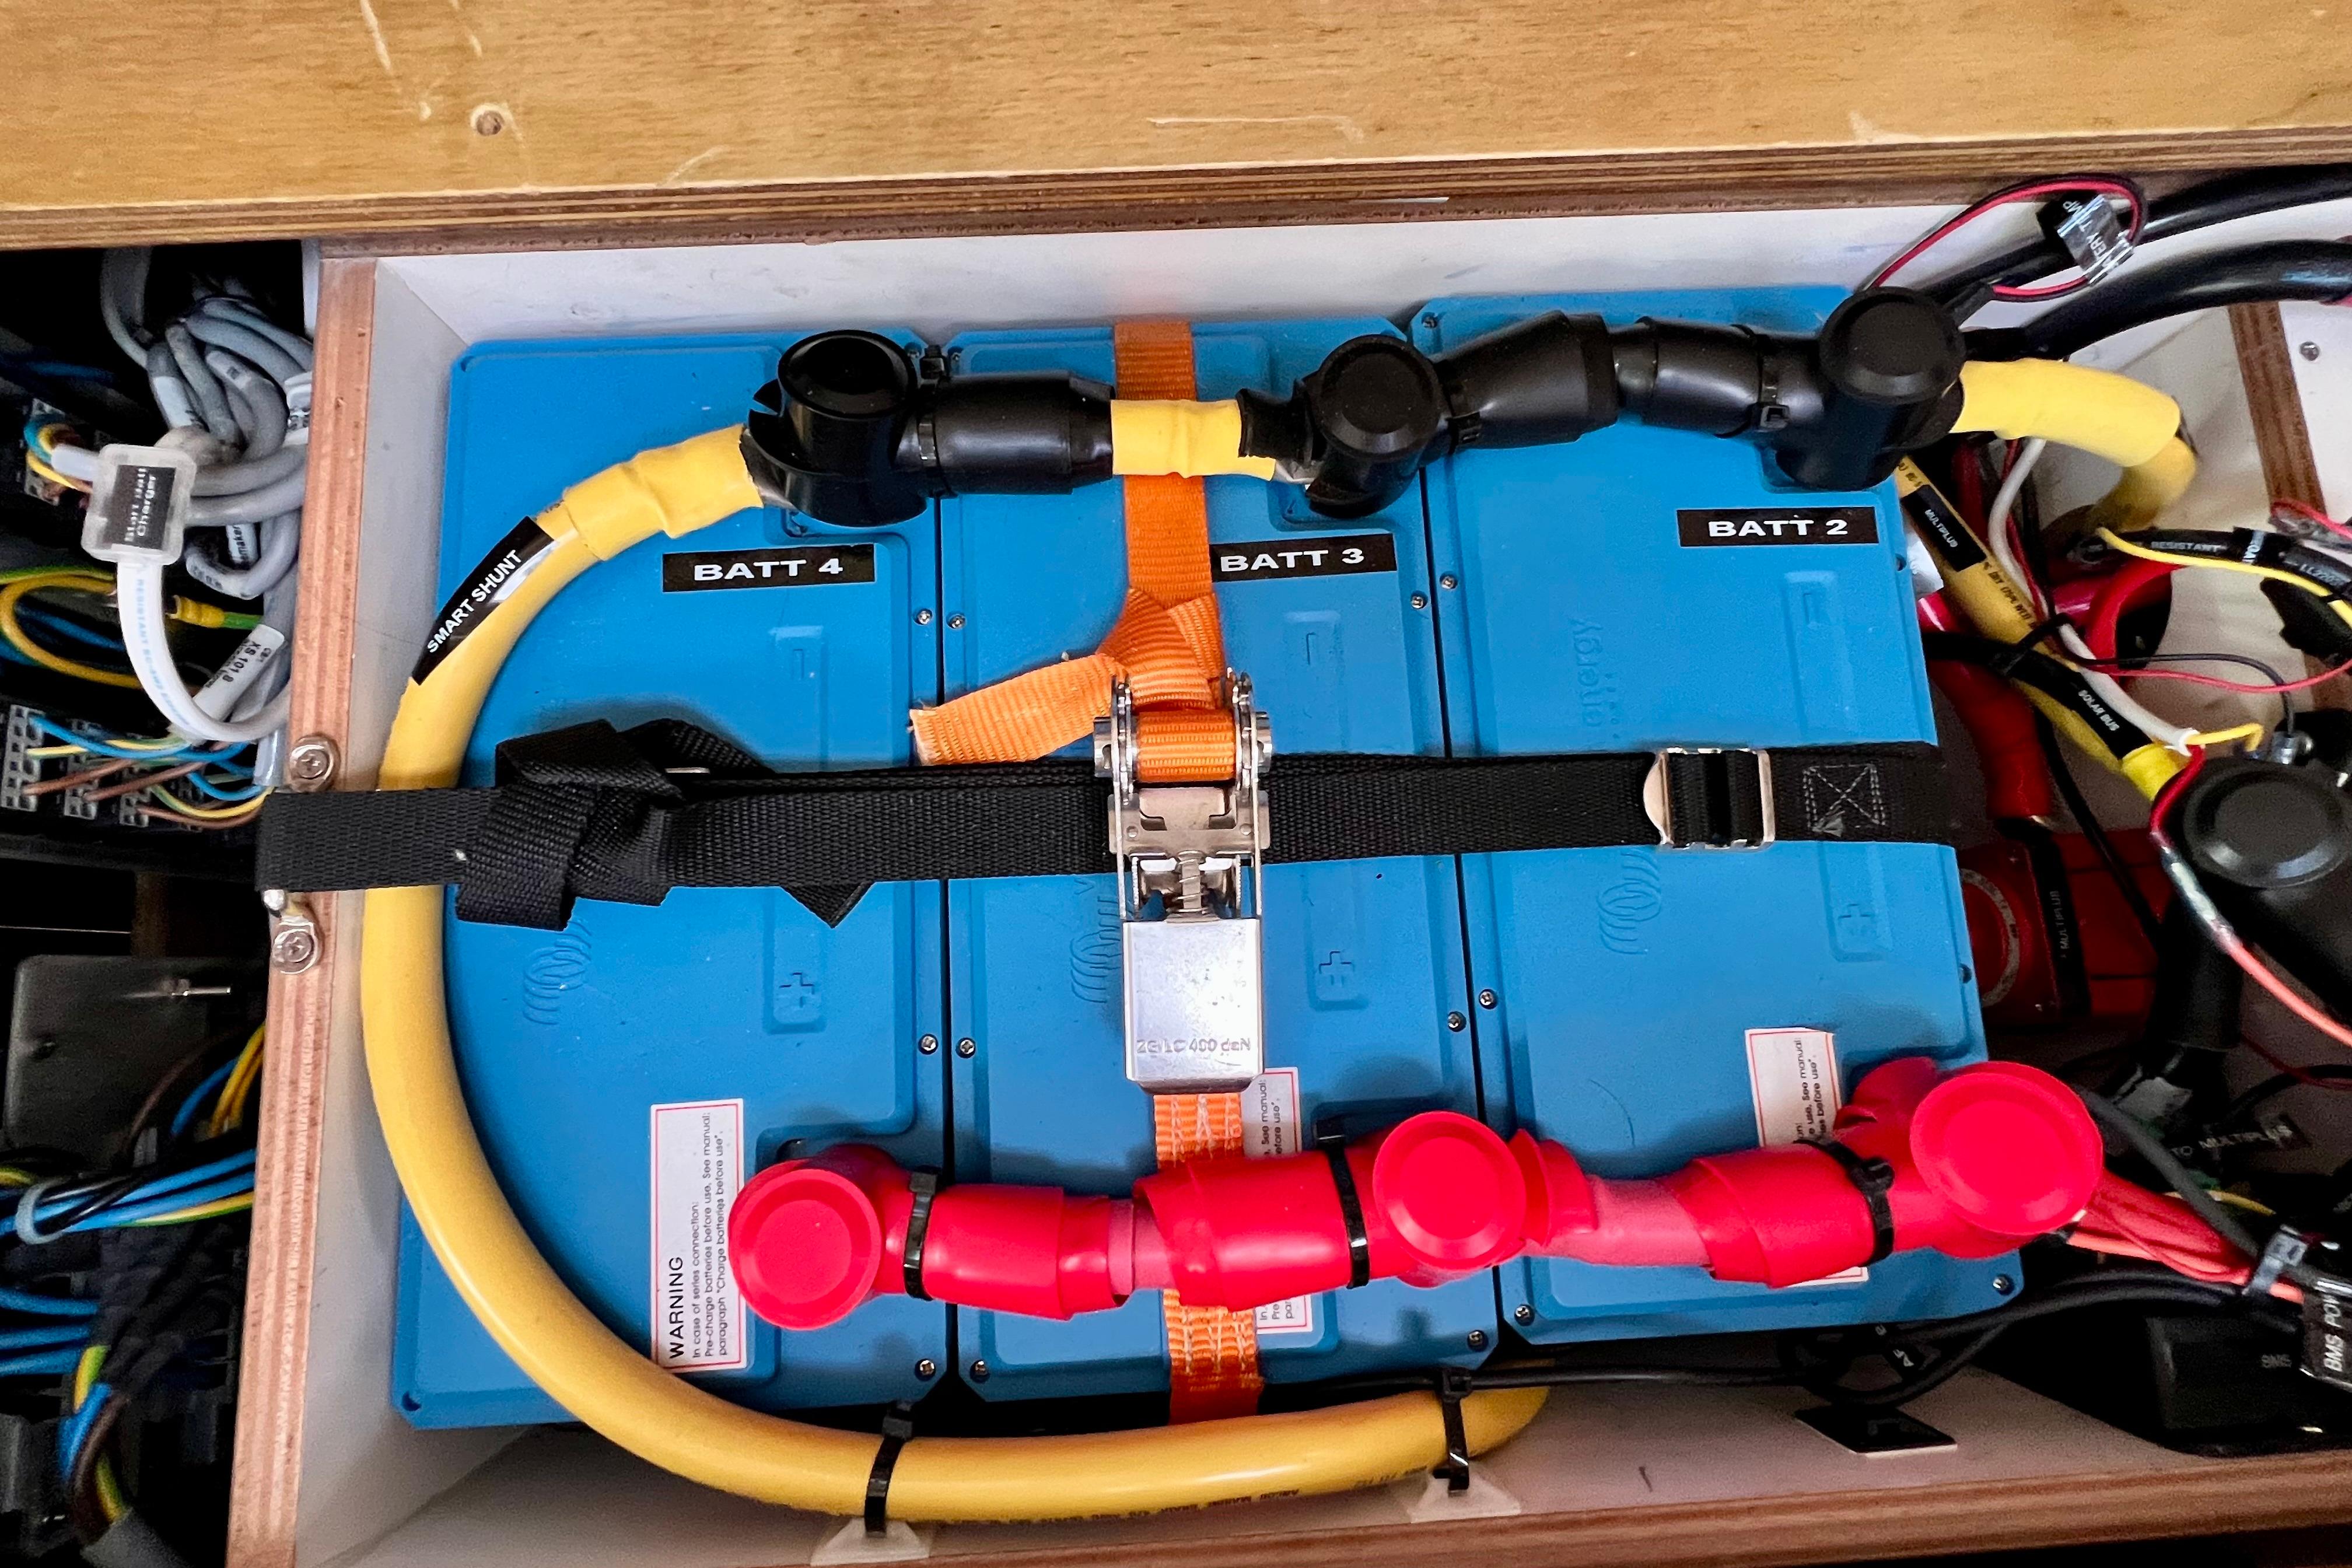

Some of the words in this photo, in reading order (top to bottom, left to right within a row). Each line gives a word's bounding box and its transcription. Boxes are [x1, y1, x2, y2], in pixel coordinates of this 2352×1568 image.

[1708, 520, 1814, 537] BATT
[1825, 519, 1848, 536] 2
[694, 559, 807, 581] BATT
[818, 558, 844, 575] 4
[1220, 550, 1329, 572] BATT
[1342, 548, 1364, 564] 3
[427, 598, 474, 653] SMART
[471, 550, 522, 602] SHUNT
[1813, 1083, 1825, 1116] before
[1274, 1127, 1282, 1155] efore
[702, 1159, 710, 1179] See
[715, 1160, 723, 1195] before
[704, 1208, 712, 1242] before
[716, 1199, 725, 1244] batteries
[691, 1270, 700, 1300] series
[704, 1246, 713, 1293] batteries
[668, 1256, 685, 1359] WARNING
[692, 1303, 701, 1314] of
[704, 1297, 715, 1357] Pre-charge
[717, 1297, 727, 1356] paragraph
[692, 1348, 701, 1359] In
[2323, 1334, 2344, 1371] BMS
